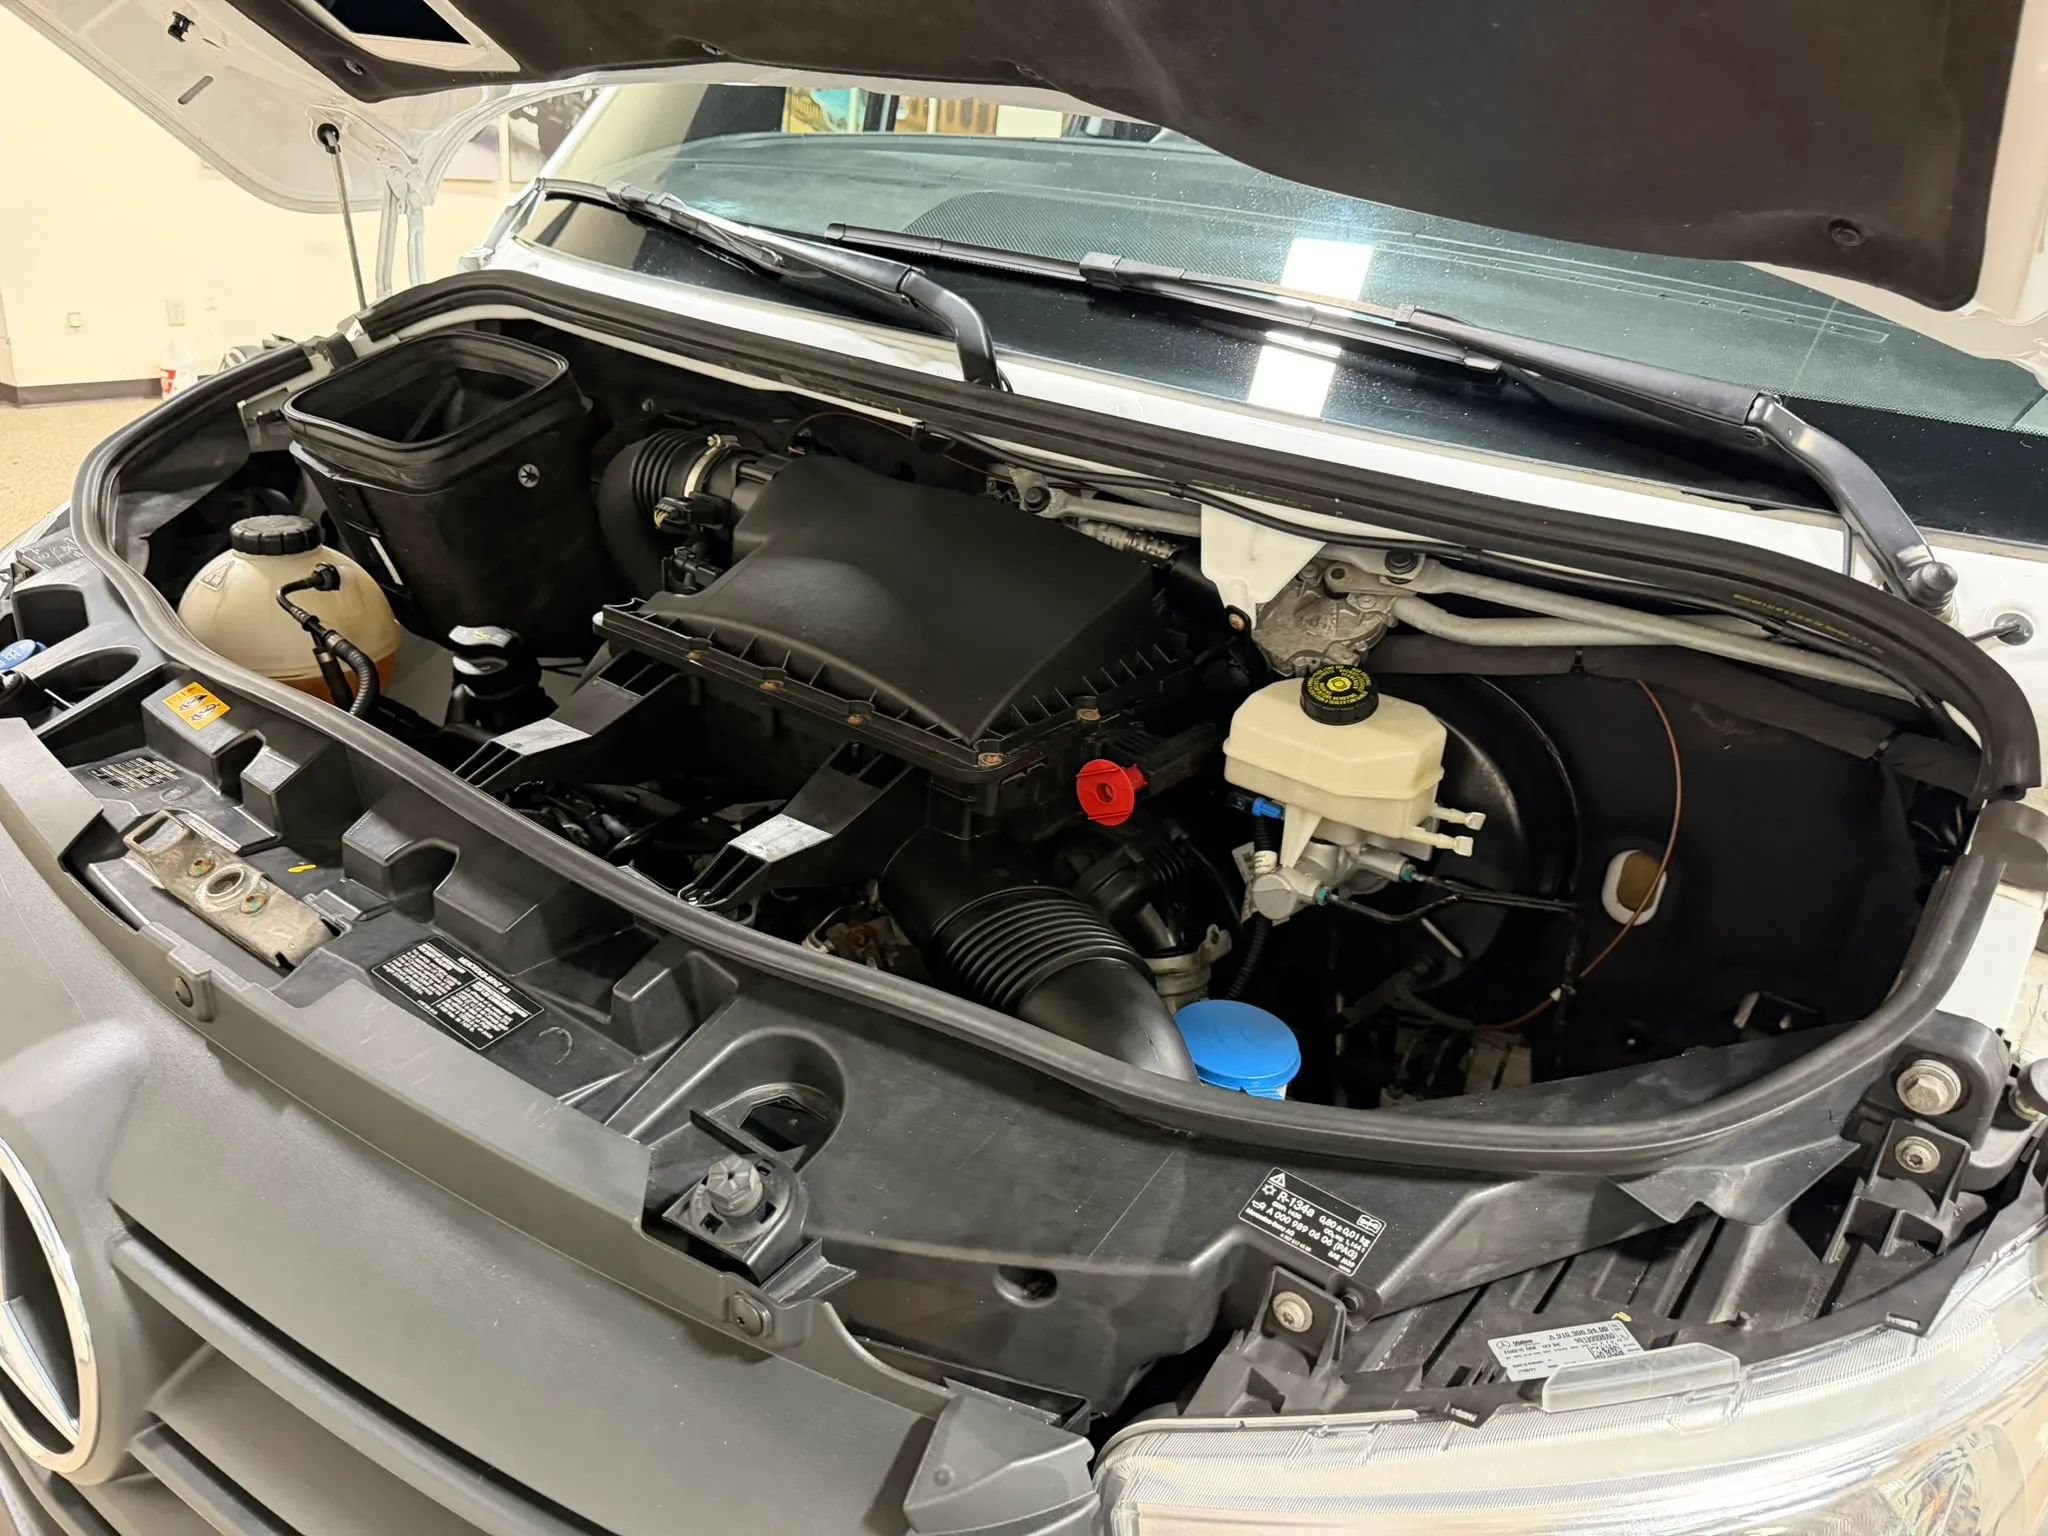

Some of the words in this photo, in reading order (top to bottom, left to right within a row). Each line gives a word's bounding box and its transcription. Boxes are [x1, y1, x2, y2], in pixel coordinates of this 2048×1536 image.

[1274, 1212, 1291, 1224] 000
[1292, 1220, 1308, 1232] 989
[1309, 1229, 1320, 1239] 06
[1321, 1236, 1333, 1246] 06
[1333, 1242, 1358, 1260] (PAG)
[1277, 1191, 1315, 1217] R-134a
[1319, 1216, 1337, 1228] 0,80
[1342, 1227, 1360, 1240] 0,01
[1359, 1236, 1371, 1247] kg
